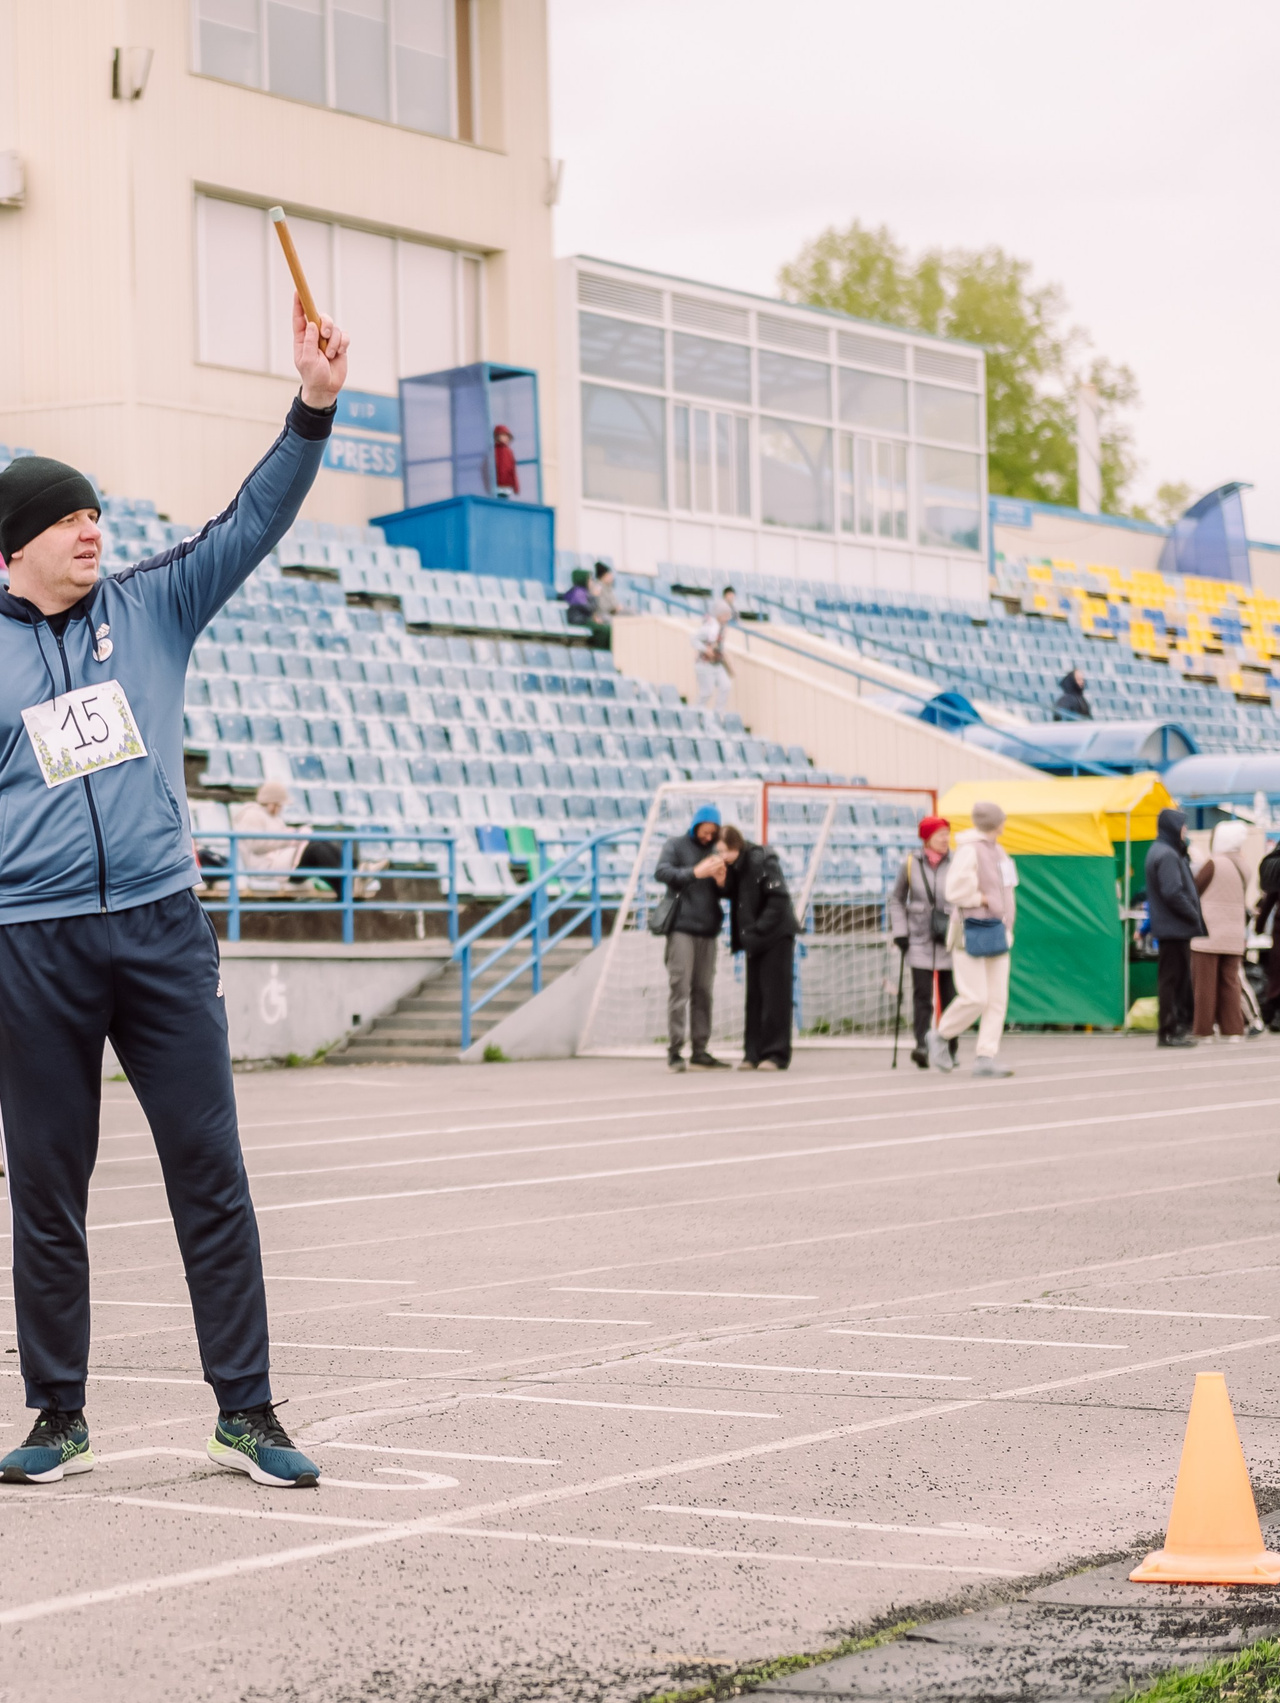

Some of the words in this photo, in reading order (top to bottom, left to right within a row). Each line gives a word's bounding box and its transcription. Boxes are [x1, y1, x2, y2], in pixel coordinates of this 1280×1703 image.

[349, 402, 375, 418] VIP
[330, 438, 397, 474] PRESS
[61, 697, 109, 750] 15
